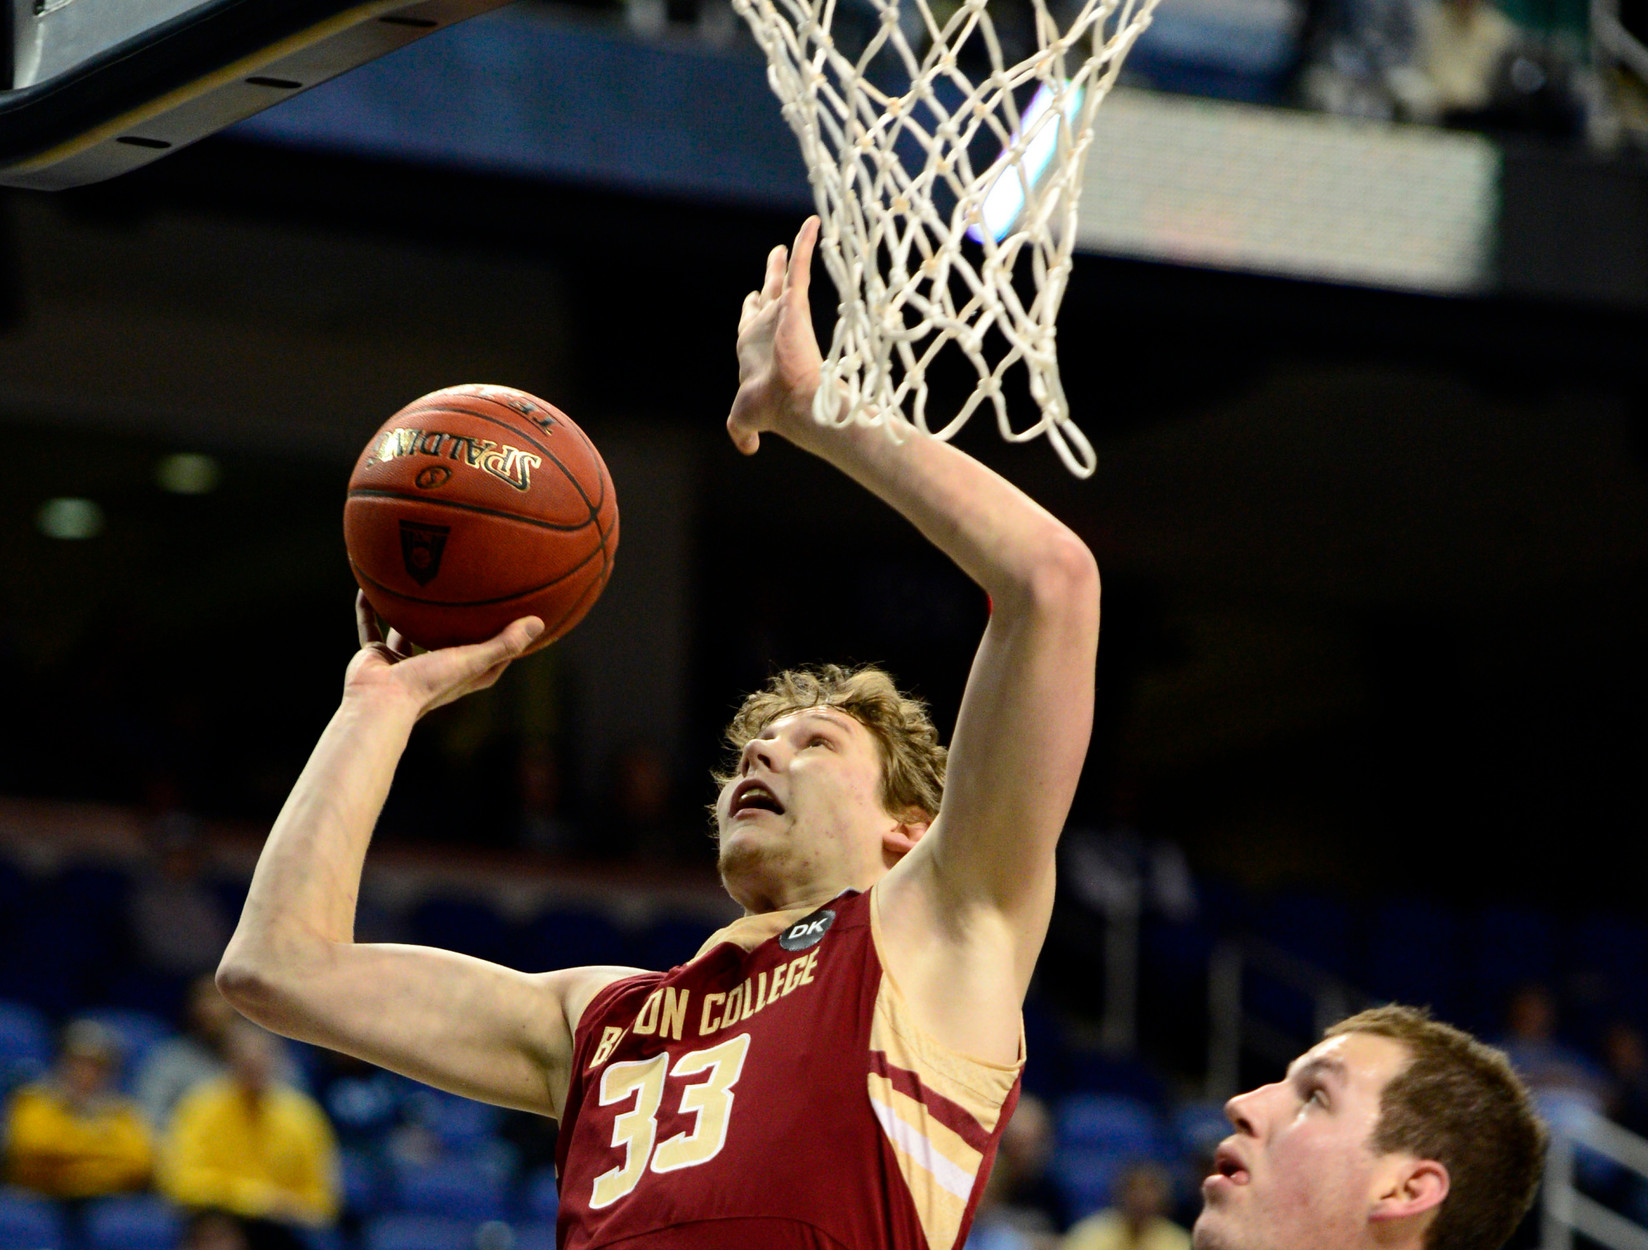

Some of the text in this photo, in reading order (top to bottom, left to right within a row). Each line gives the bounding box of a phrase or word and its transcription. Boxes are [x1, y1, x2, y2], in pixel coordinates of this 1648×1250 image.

[787, 917, 828, 940] DK
[699, 947, 820, 1036] COLLEGE
[589, 1033, 750, 1210] 33
